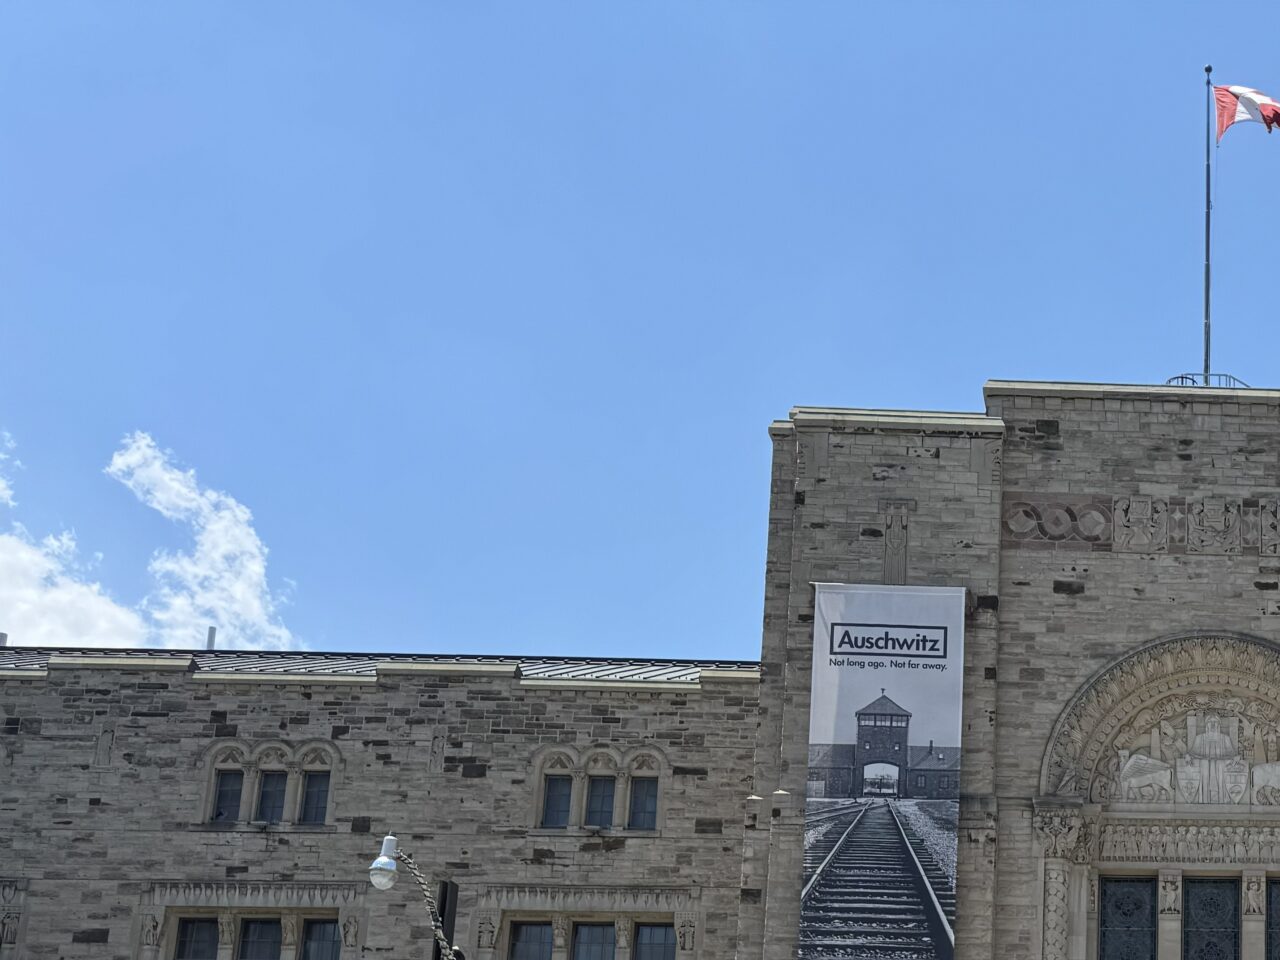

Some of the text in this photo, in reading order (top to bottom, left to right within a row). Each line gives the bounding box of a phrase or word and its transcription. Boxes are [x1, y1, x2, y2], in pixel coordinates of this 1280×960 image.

[838, 630, 940, 651] Auschwitz
[829, 658, 948, 673] Not long ago. Not far away.
